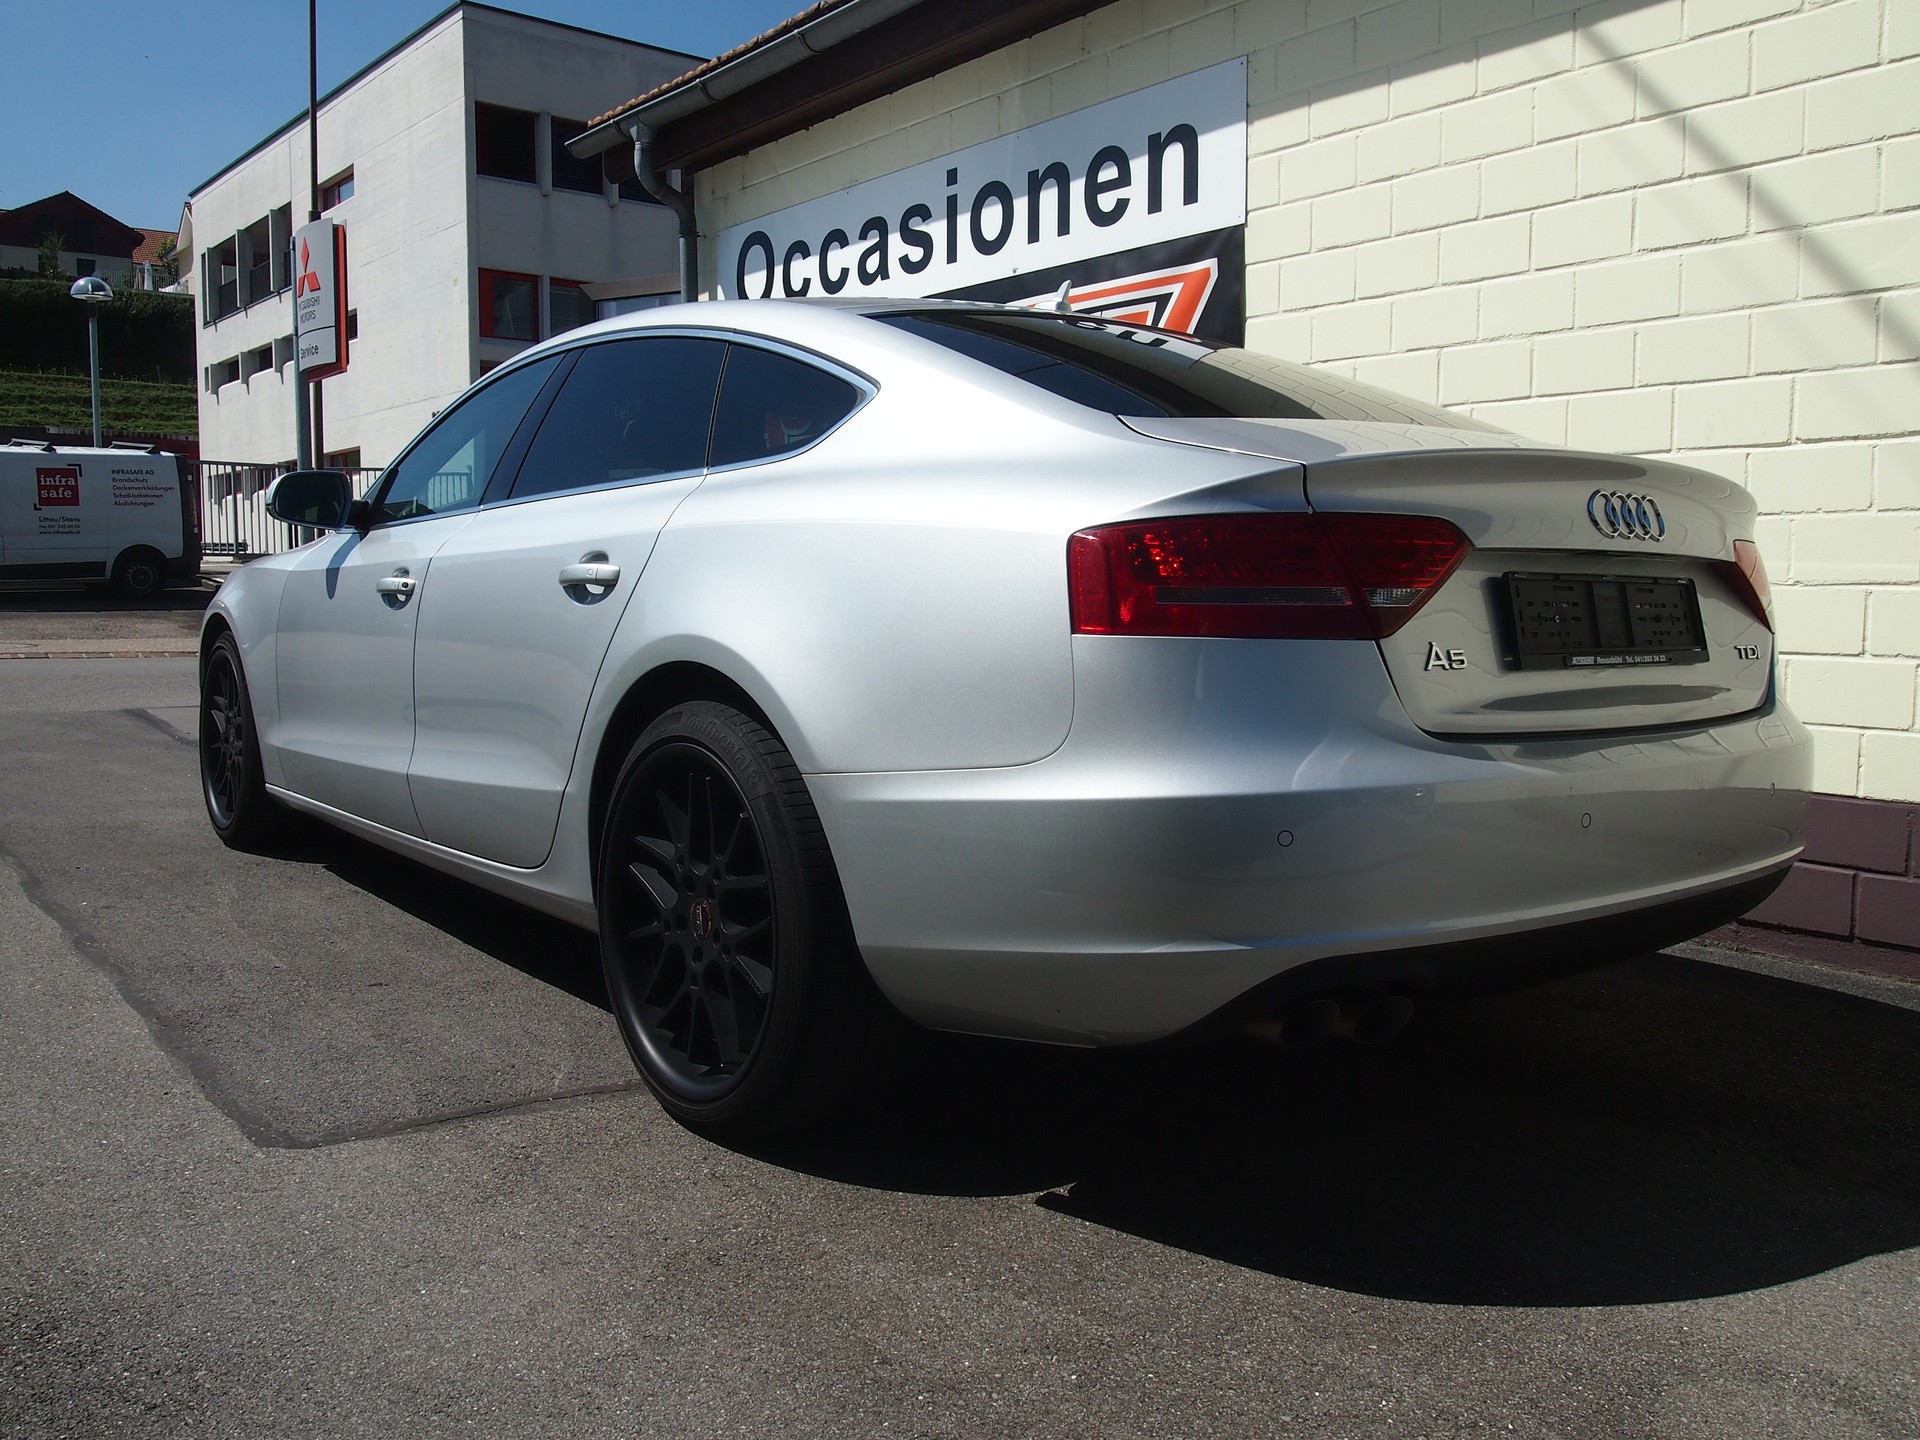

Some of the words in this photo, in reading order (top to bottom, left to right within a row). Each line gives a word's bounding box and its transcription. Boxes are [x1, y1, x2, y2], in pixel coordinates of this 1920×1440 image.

[737, 123, 1199, 299] Occasionen
[300, 344, 319, 359] Service
[40, 475, 76, 486] infra
[41, 488, 72, 498] safe
[1425, 641, 1468, 670] A5
[1734, 645, 1761, 659] TDI
